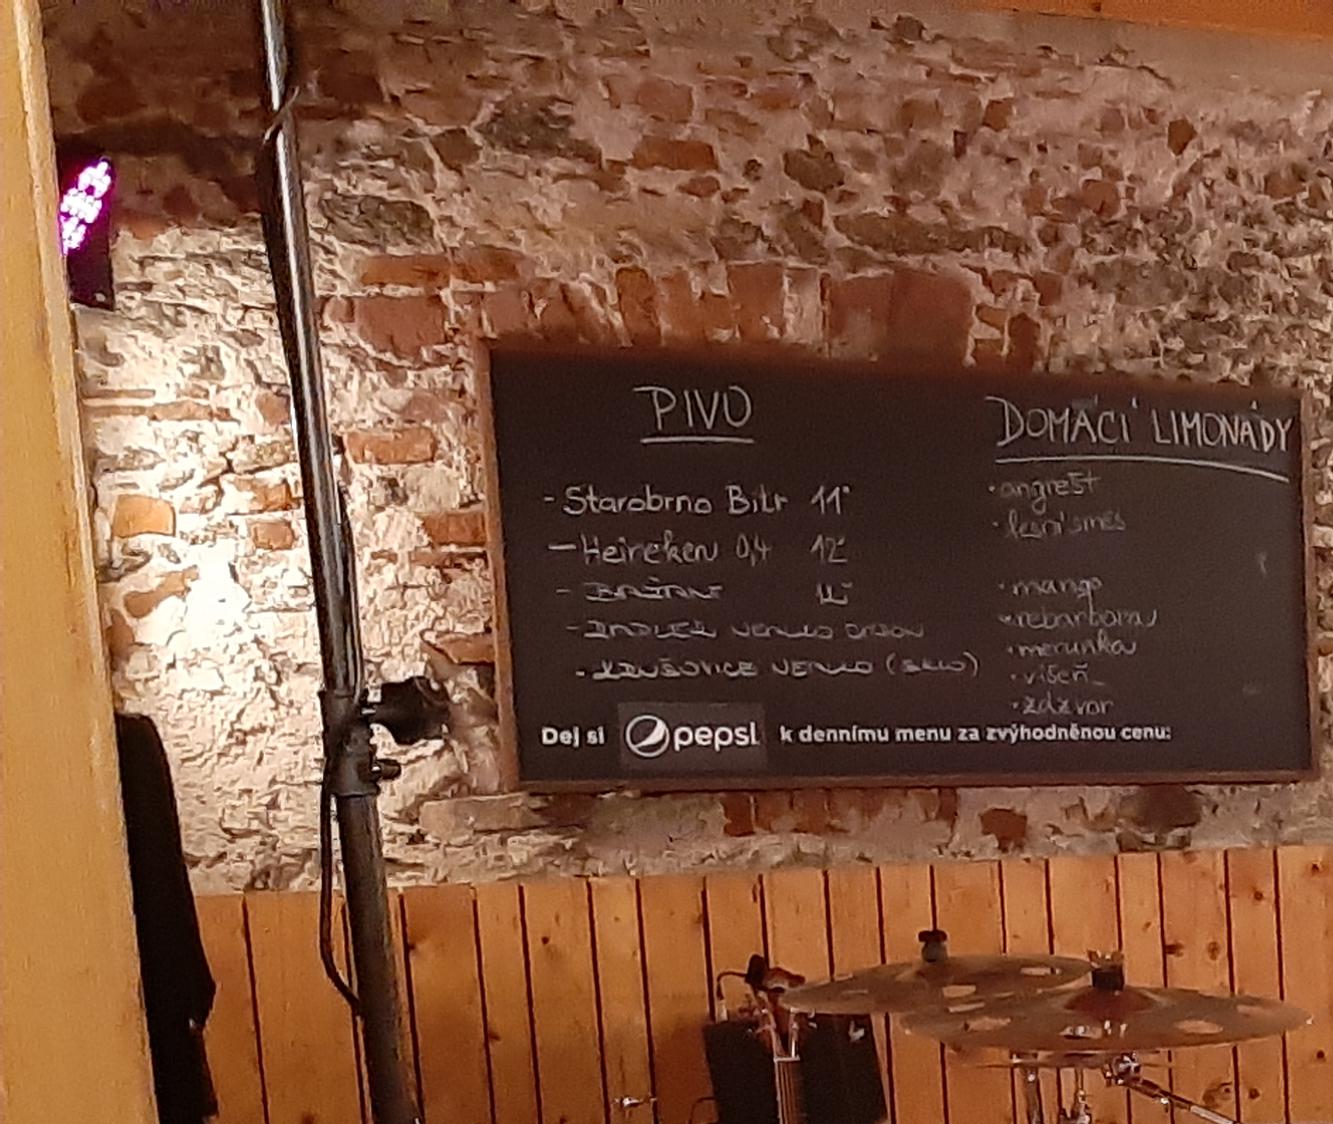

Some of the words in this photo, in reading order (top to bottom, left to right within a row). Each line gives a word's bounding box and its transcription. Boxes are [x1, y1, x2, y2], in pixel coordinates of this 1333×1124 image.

[633, 386, 752, 430] PIVO
[986, 395, 1137, 446] DOMÁCÍ
[1151, 399, 1294, 453] LIMONÁDY
[562, 483, 712, 515] Starobrno
[541, 726, 580, 748] Dej
[586, 726, 605, 745] si
[673, 721, 760, 752] pepsi
[780, 725, 794, 743] k
[798, 724, 889, 743] dennímu
[895, 727, 950, 742] menu
[957, 728, 979, 742] za
[986, 723, 1117, 745] zvýhodněnou
[1119, 726, 1172, 742] cenu:
